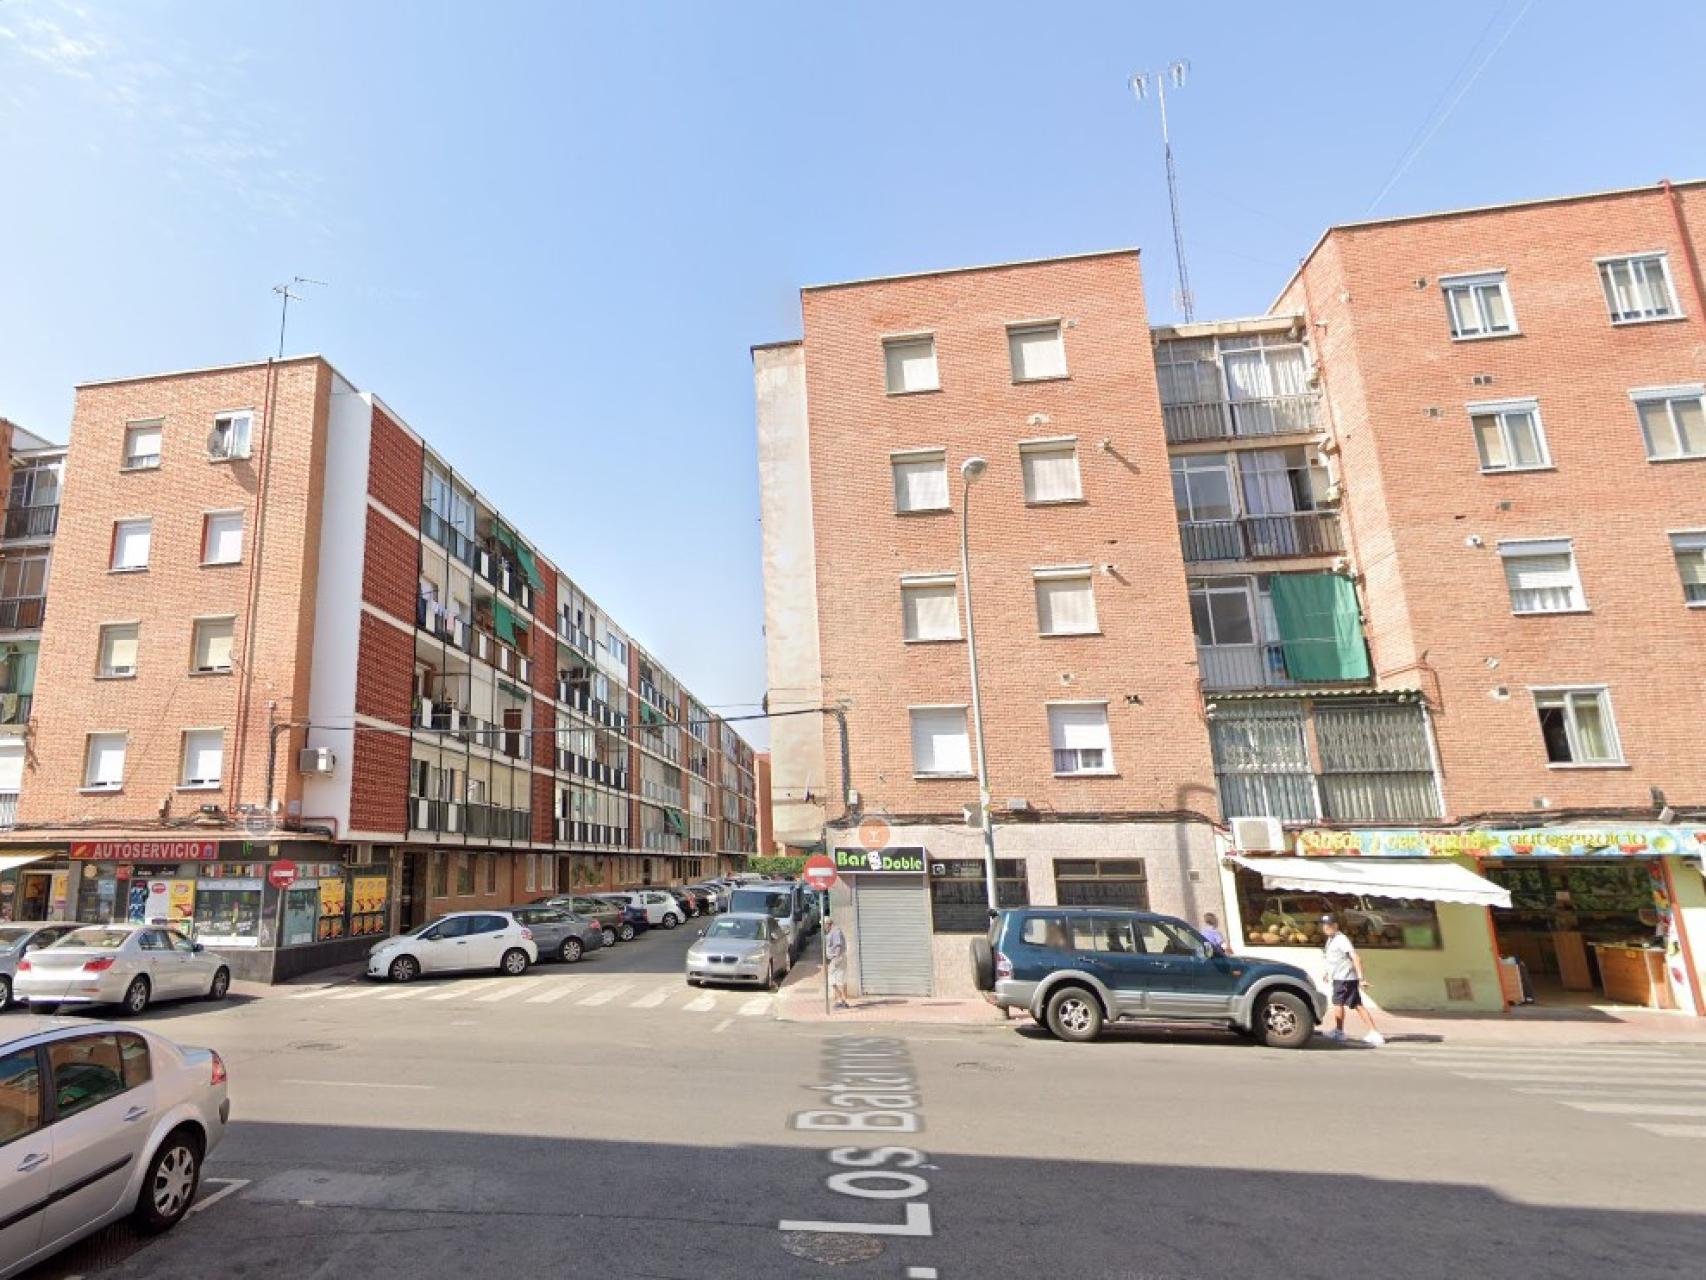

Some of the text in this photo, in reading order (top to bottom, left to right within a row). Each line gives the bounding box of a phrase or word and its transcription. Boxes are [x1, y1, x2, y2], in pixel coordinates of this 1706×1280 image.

[93, 843, 200, 858] AUTOSERVICIO
[837, 851, 922, 871] Bar Doble
